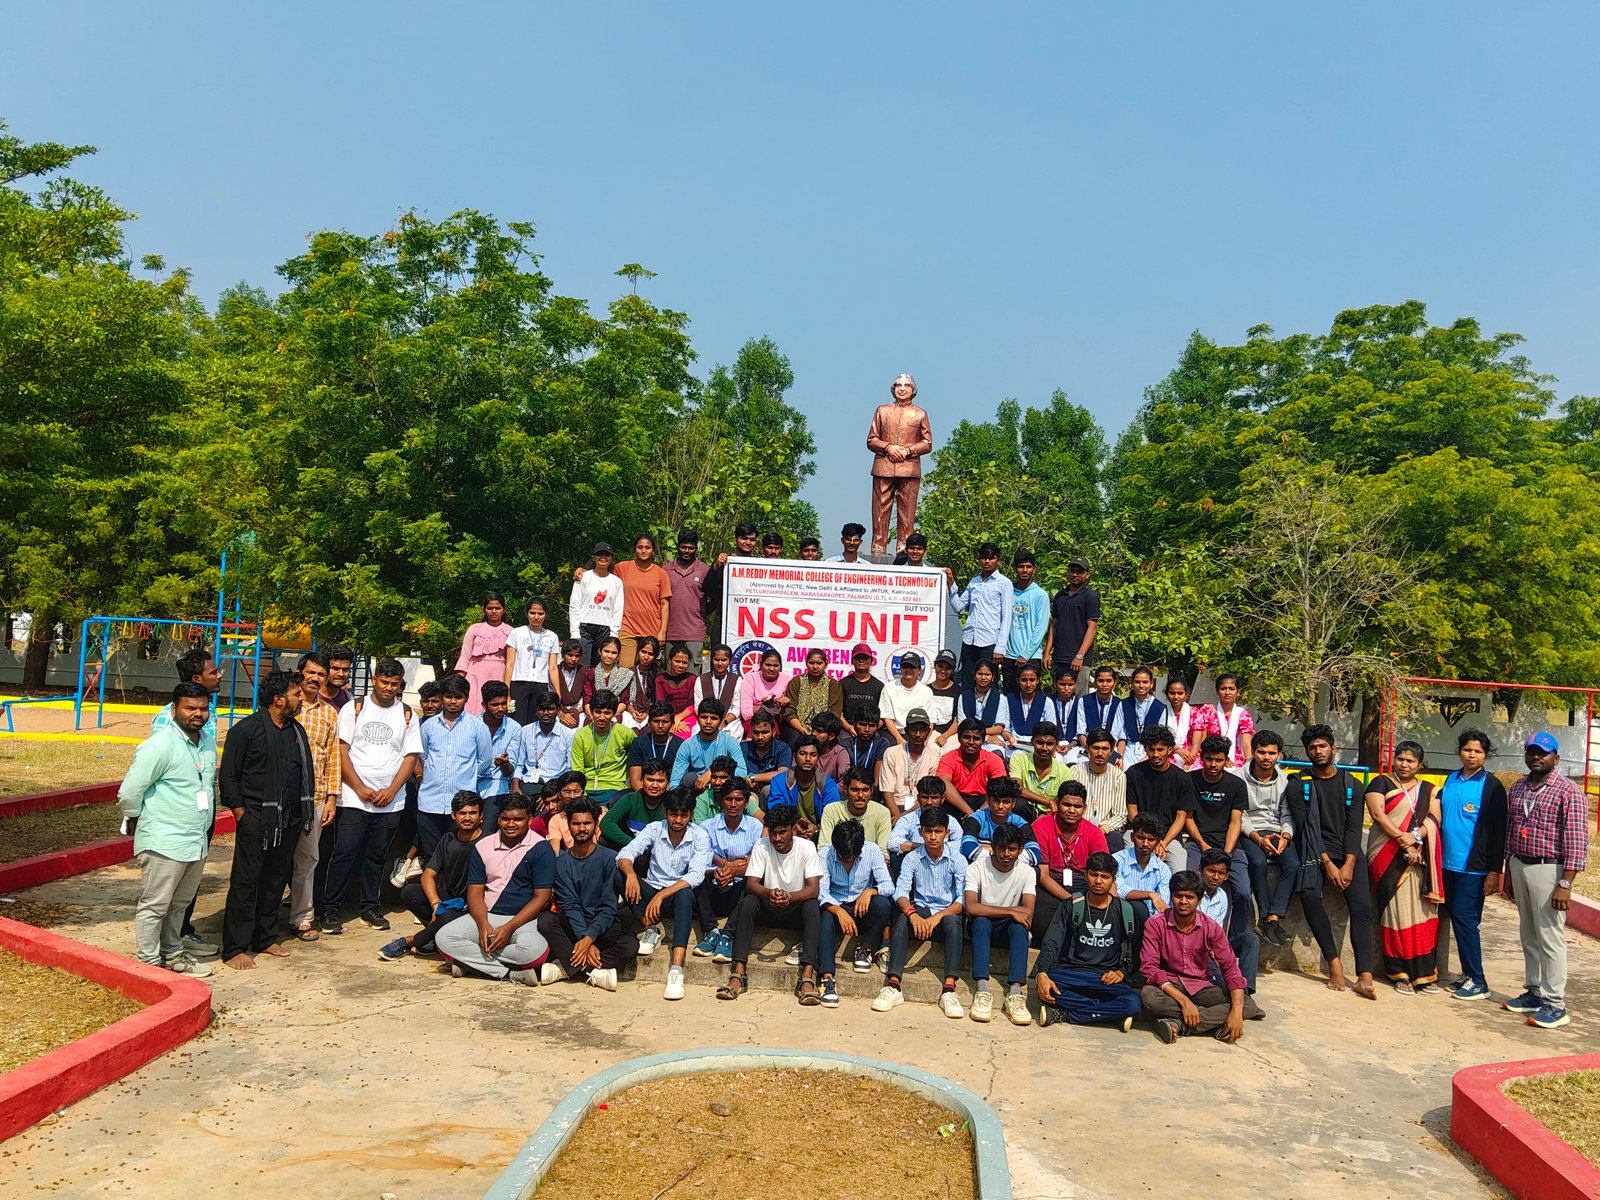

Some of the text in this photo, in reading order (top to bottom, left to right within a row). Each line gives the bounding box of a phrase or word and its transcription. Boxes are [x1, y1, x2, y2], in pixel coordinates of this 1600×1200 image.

[732, 568, 938, 588] A.M.REDDY MEMORIAL COLLEGE OF ENGINEERING & TECHNOLOGY
[749, 581, 778, 589] (Approved
[737, 606, 928, 645] NSS UNIT
[1079, 934, 1115, 948] adidas
